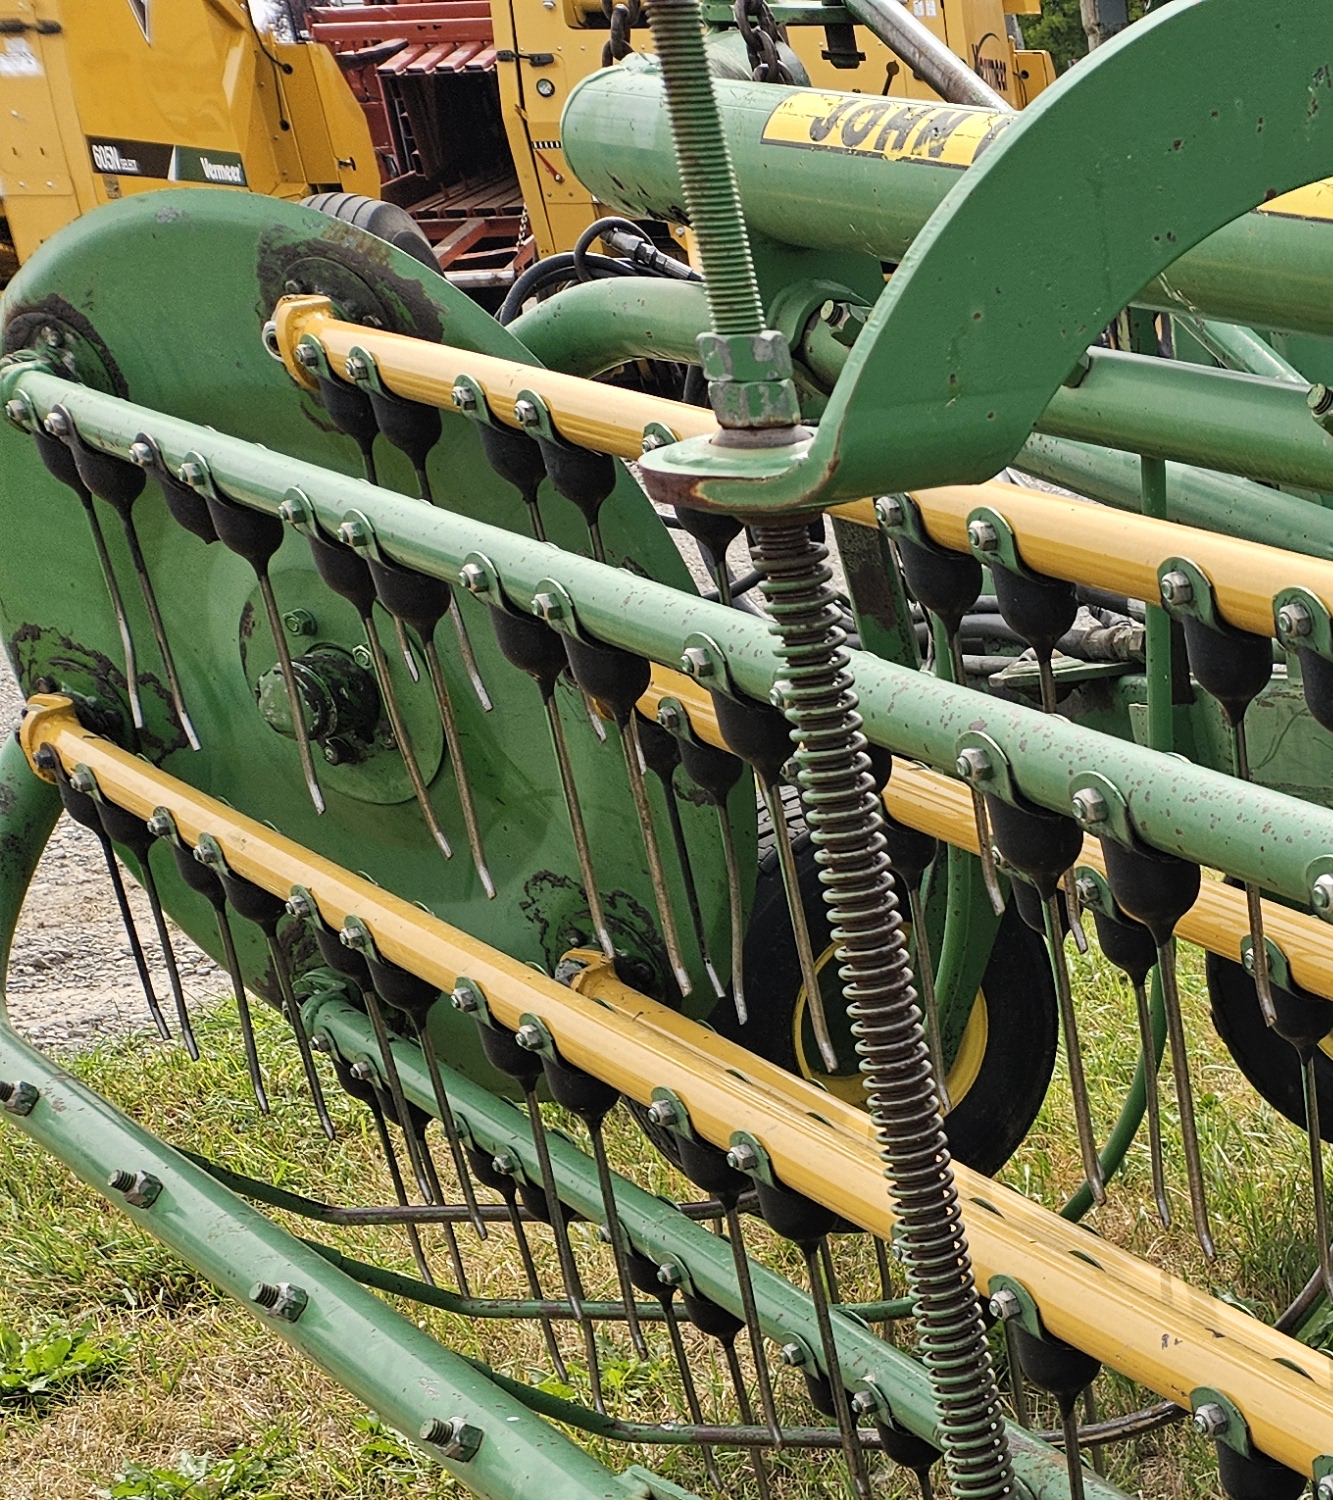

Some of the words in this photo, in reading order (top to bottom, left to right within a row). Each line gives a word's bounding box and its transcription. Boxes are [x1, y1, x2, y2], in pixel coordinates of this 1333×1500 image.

[808, 100, 976, 158] JOHN
[91, 144, 122, 172] 605N
[199, 157, 242, 182] Vermeer
